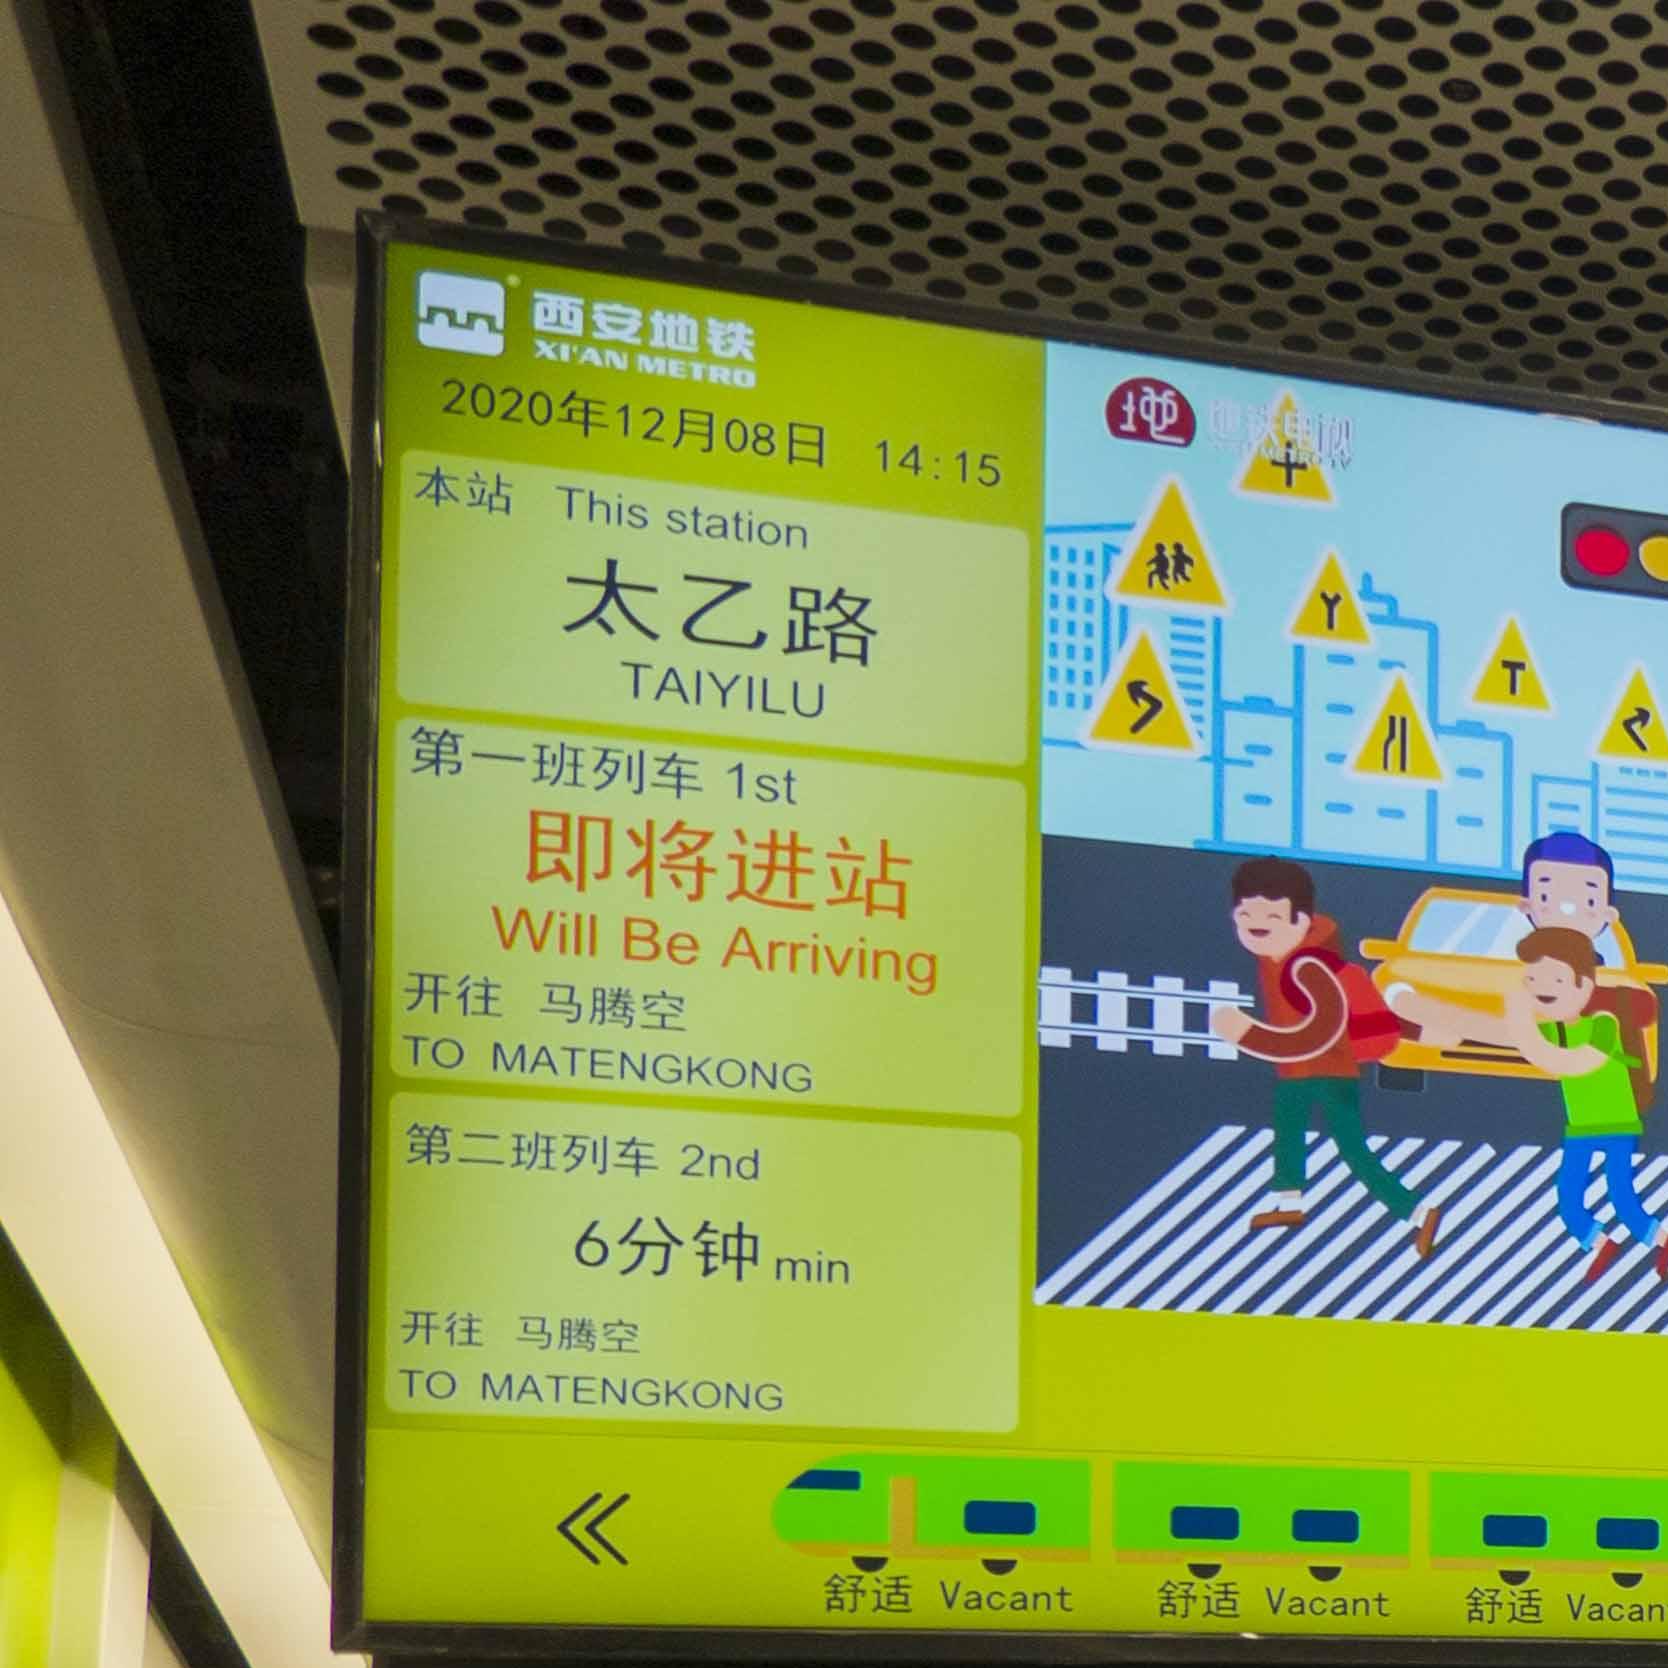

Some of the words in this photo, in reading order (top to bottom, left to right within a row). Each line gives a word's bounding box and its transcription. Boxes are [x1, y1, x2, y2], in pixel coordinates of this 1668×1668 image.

[530, 288, 757, 363] 西安地铁
[533, 339, 629, 373] XI'AN
[636, 352, 756, 388] METRO
[440, 377, 827, 469] 2020年12月08日
[874, 439, 1002, 488] 14:15
[416, 465, 513, 516] 本站
[556, 485, 649, 531] This
[667, 504, 808, 550] station
[562, 558, 878, 667] 太乙路
[621, 662, 825, 719] TAIYILU
[409, 726, 703, 800] 第一班列车
[727, 762, 797, 805] 1st
[526, 809, 912, 920] 即将进站
[491, 906, 596, 957] Will
[623, 917, 698, 965] Be
[722, 927, 937, 996] Arriving
[404, 972, 502, 1018] 开往
[540, 982, 685, 1032] 马腾空
[403, 1036, 464, 1069] TO
[493, 1043, 812, 1093] MATENGKONG
[406, 1123, 660, 1177] 第二班列车
[681, 1144, 760, 1181] 2nd
[574, 1217, 759, 1282] 6分钟
[775, 1252, 849, 1286] min
[401, 1311, 483, 1349] 开往
[517, 1315, 640, 1354] 马腾空
[399, 1370, 456, 1399] TO
[482, 1372, 784, 1412] MATENGKONG
[824, 1573, 911, 1614] 舒适
[939, 1581, 1073, 1613] Vacant
[1158, 1580, 1240, 1619] 舒适
[1266, 1587, 1390, 1617] Vacant
[1466, 1587, 1543, 1627] 舒适
